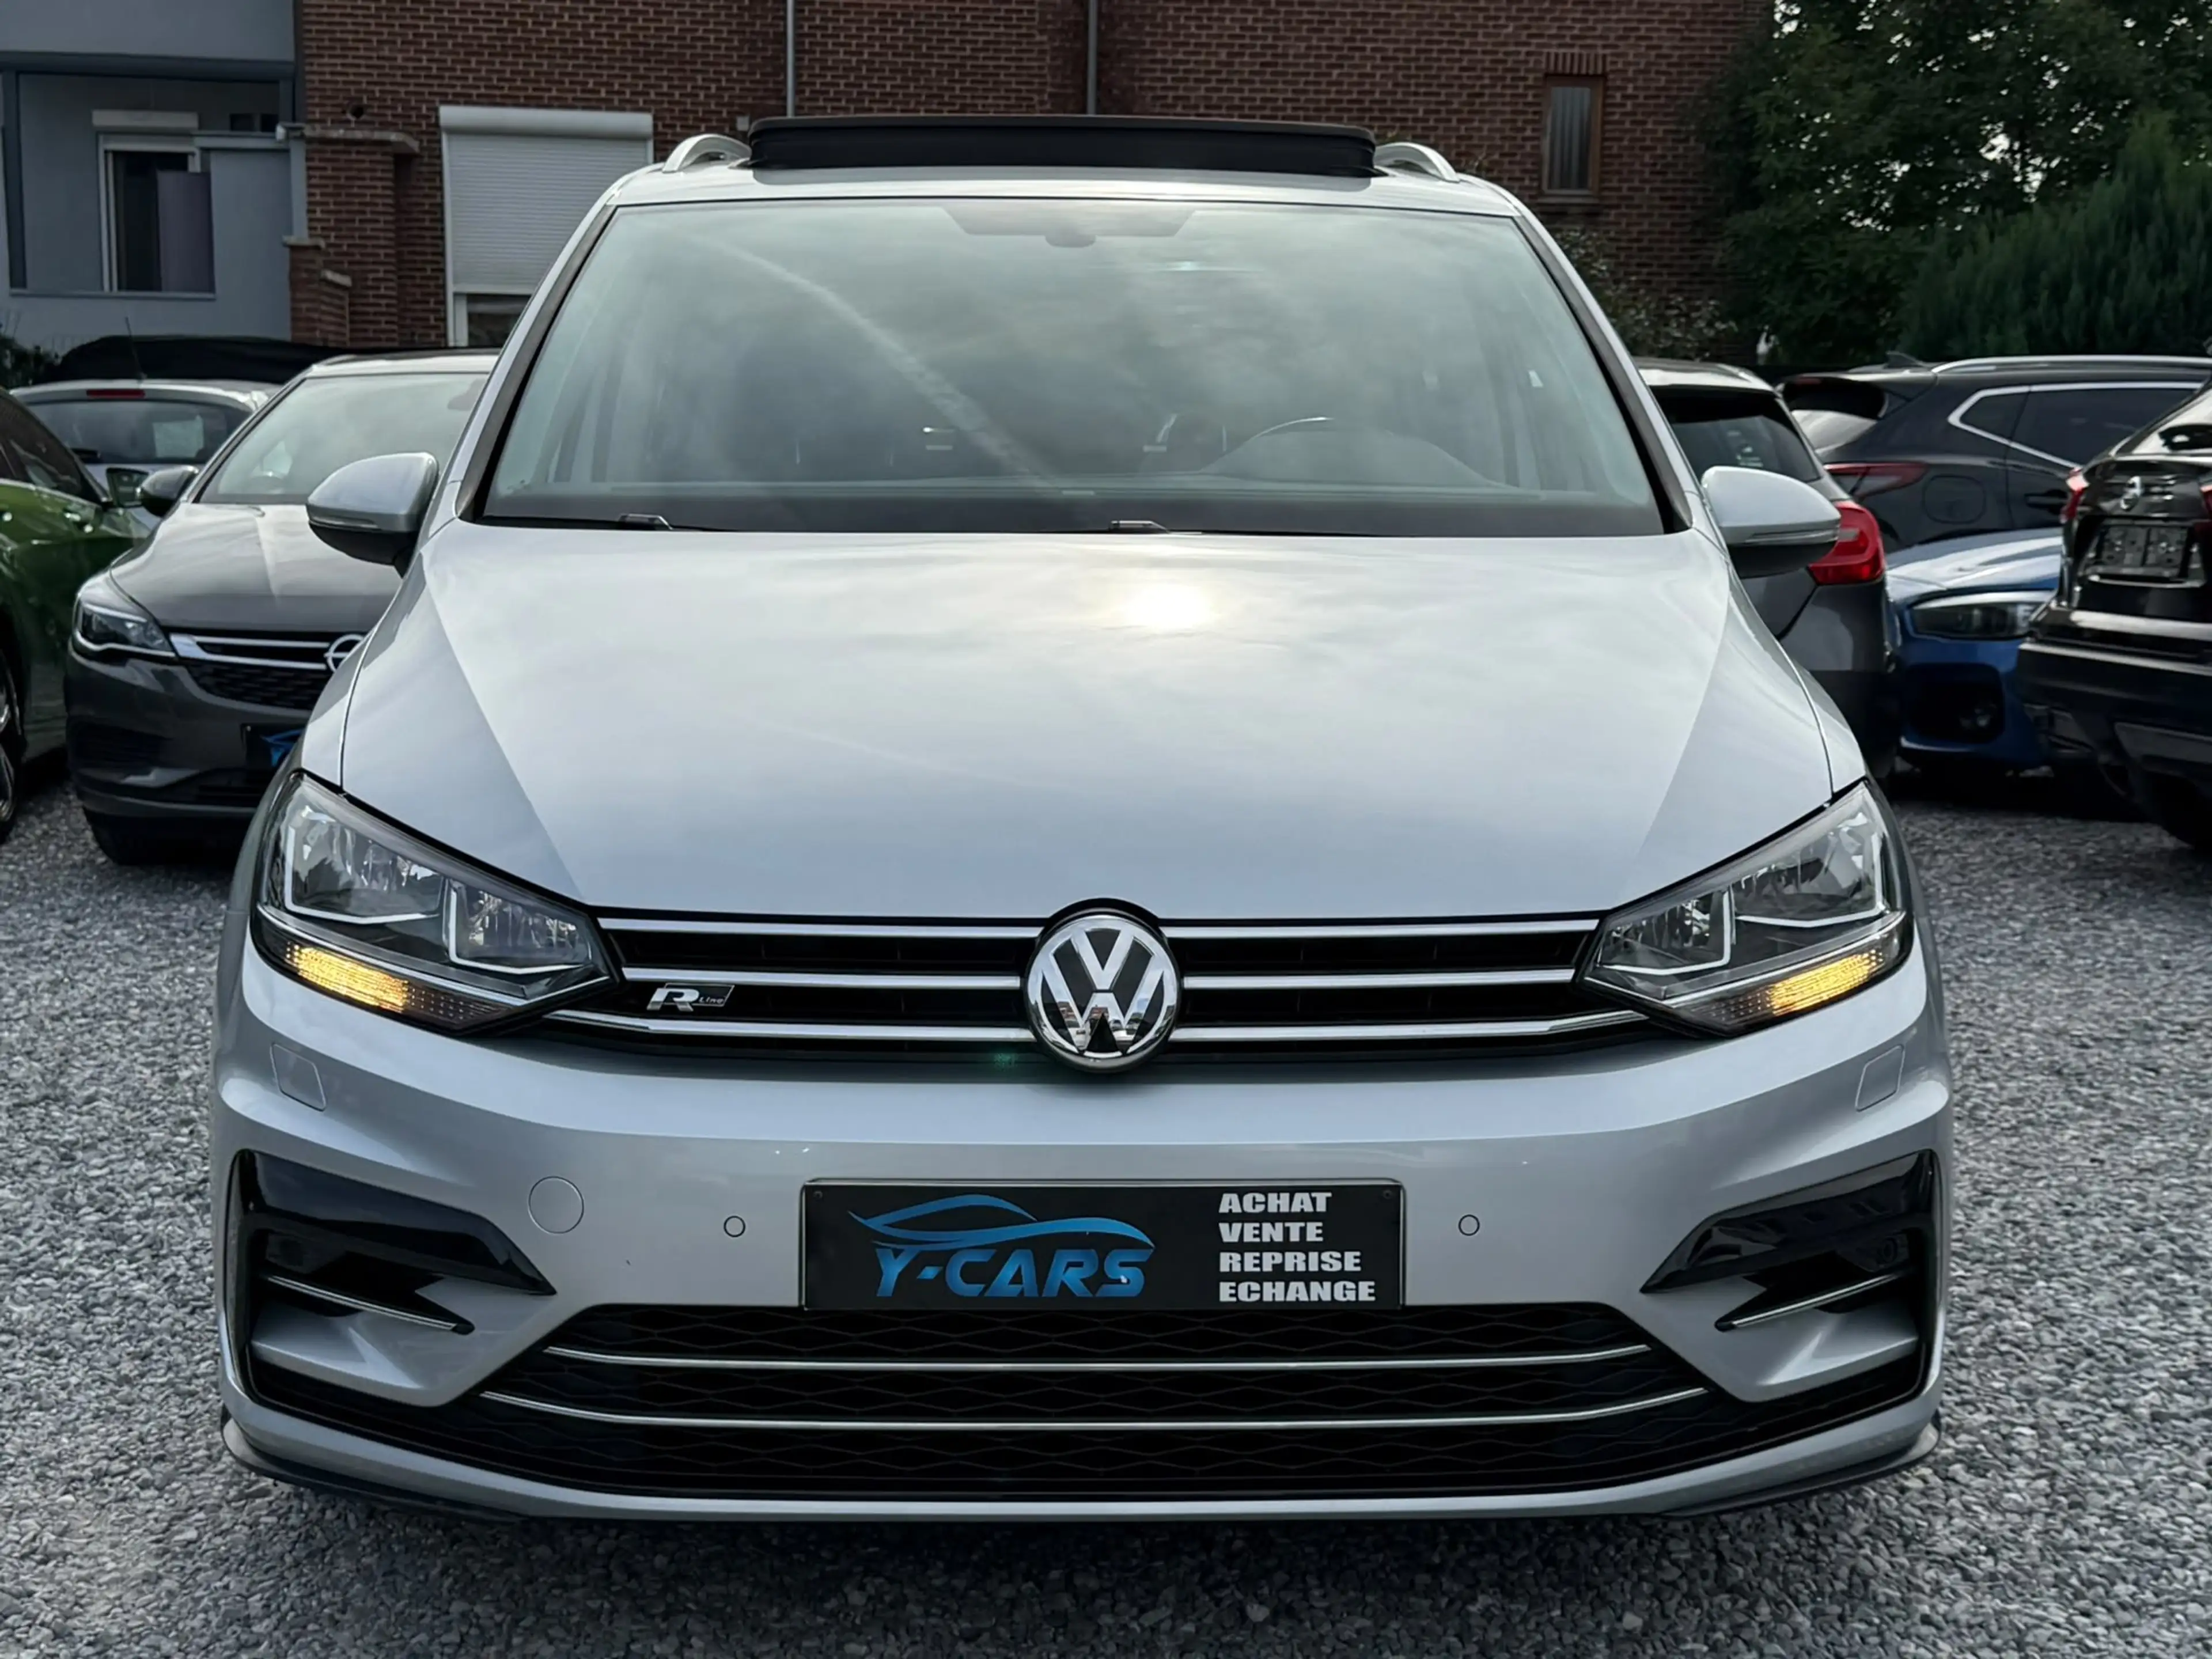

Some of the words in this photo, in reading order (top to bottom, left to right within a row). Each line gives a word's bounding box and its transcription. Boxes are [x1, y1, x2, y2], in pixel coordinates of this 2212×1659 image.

[646, 987, 699, 1012] R
[1218, 1192, 1332, 1213] ACHAT
[1218, 1222, 1324, 1243] VENTE
[1219, 1251, 1361, 1272] REPRISE
[875, 1248, 1154, 1297] Y-CARS
[1219, 1281, 1376, 1302] ECHANGE
